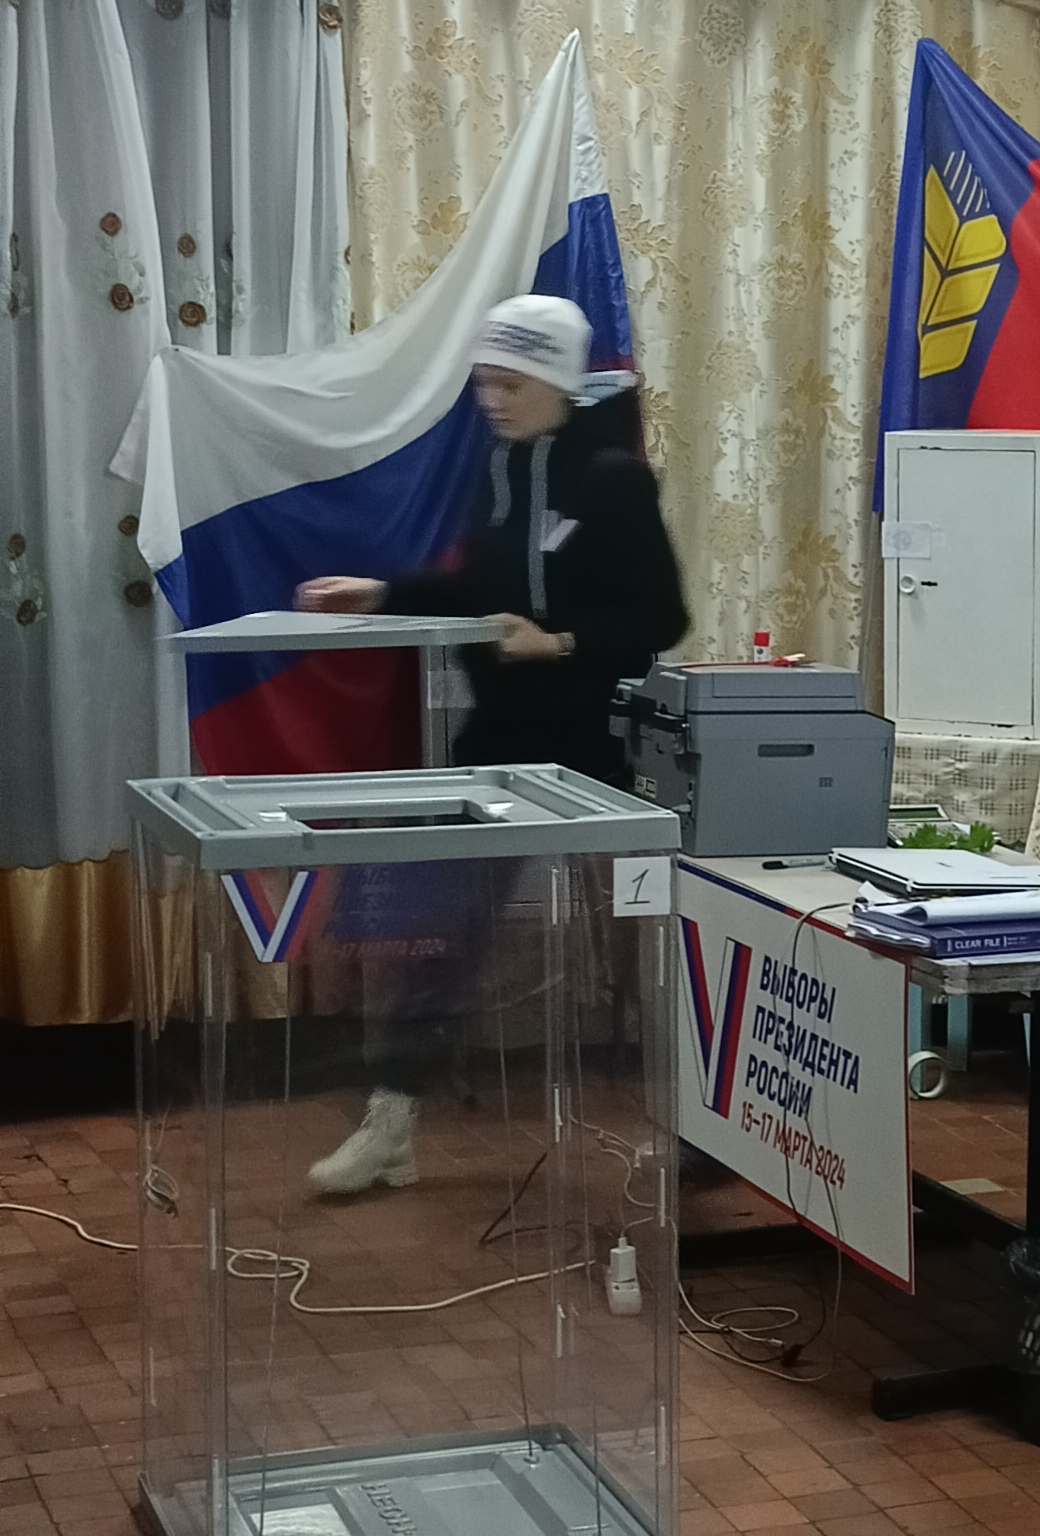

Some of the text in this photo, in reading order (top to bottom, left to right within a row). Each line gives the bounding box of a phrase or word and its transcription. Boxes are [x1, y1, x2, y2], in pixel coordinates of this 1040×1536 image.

[624, 868, 650, 905] 1
[409, 938, 447, 956] 2024
[954, 938, 981, 951] CLEAR
[984, 936, 1001, 949] FILE
[759, 954, 837, 1024] ВЫБОРЫ
[752, 1004, 861, 1095] ПРЕЗИДЕНТА
[745, 1053, 813, 1121] РОССИИ
[740, 1100, 846, 1190] 15–17 МАРТА 2024
